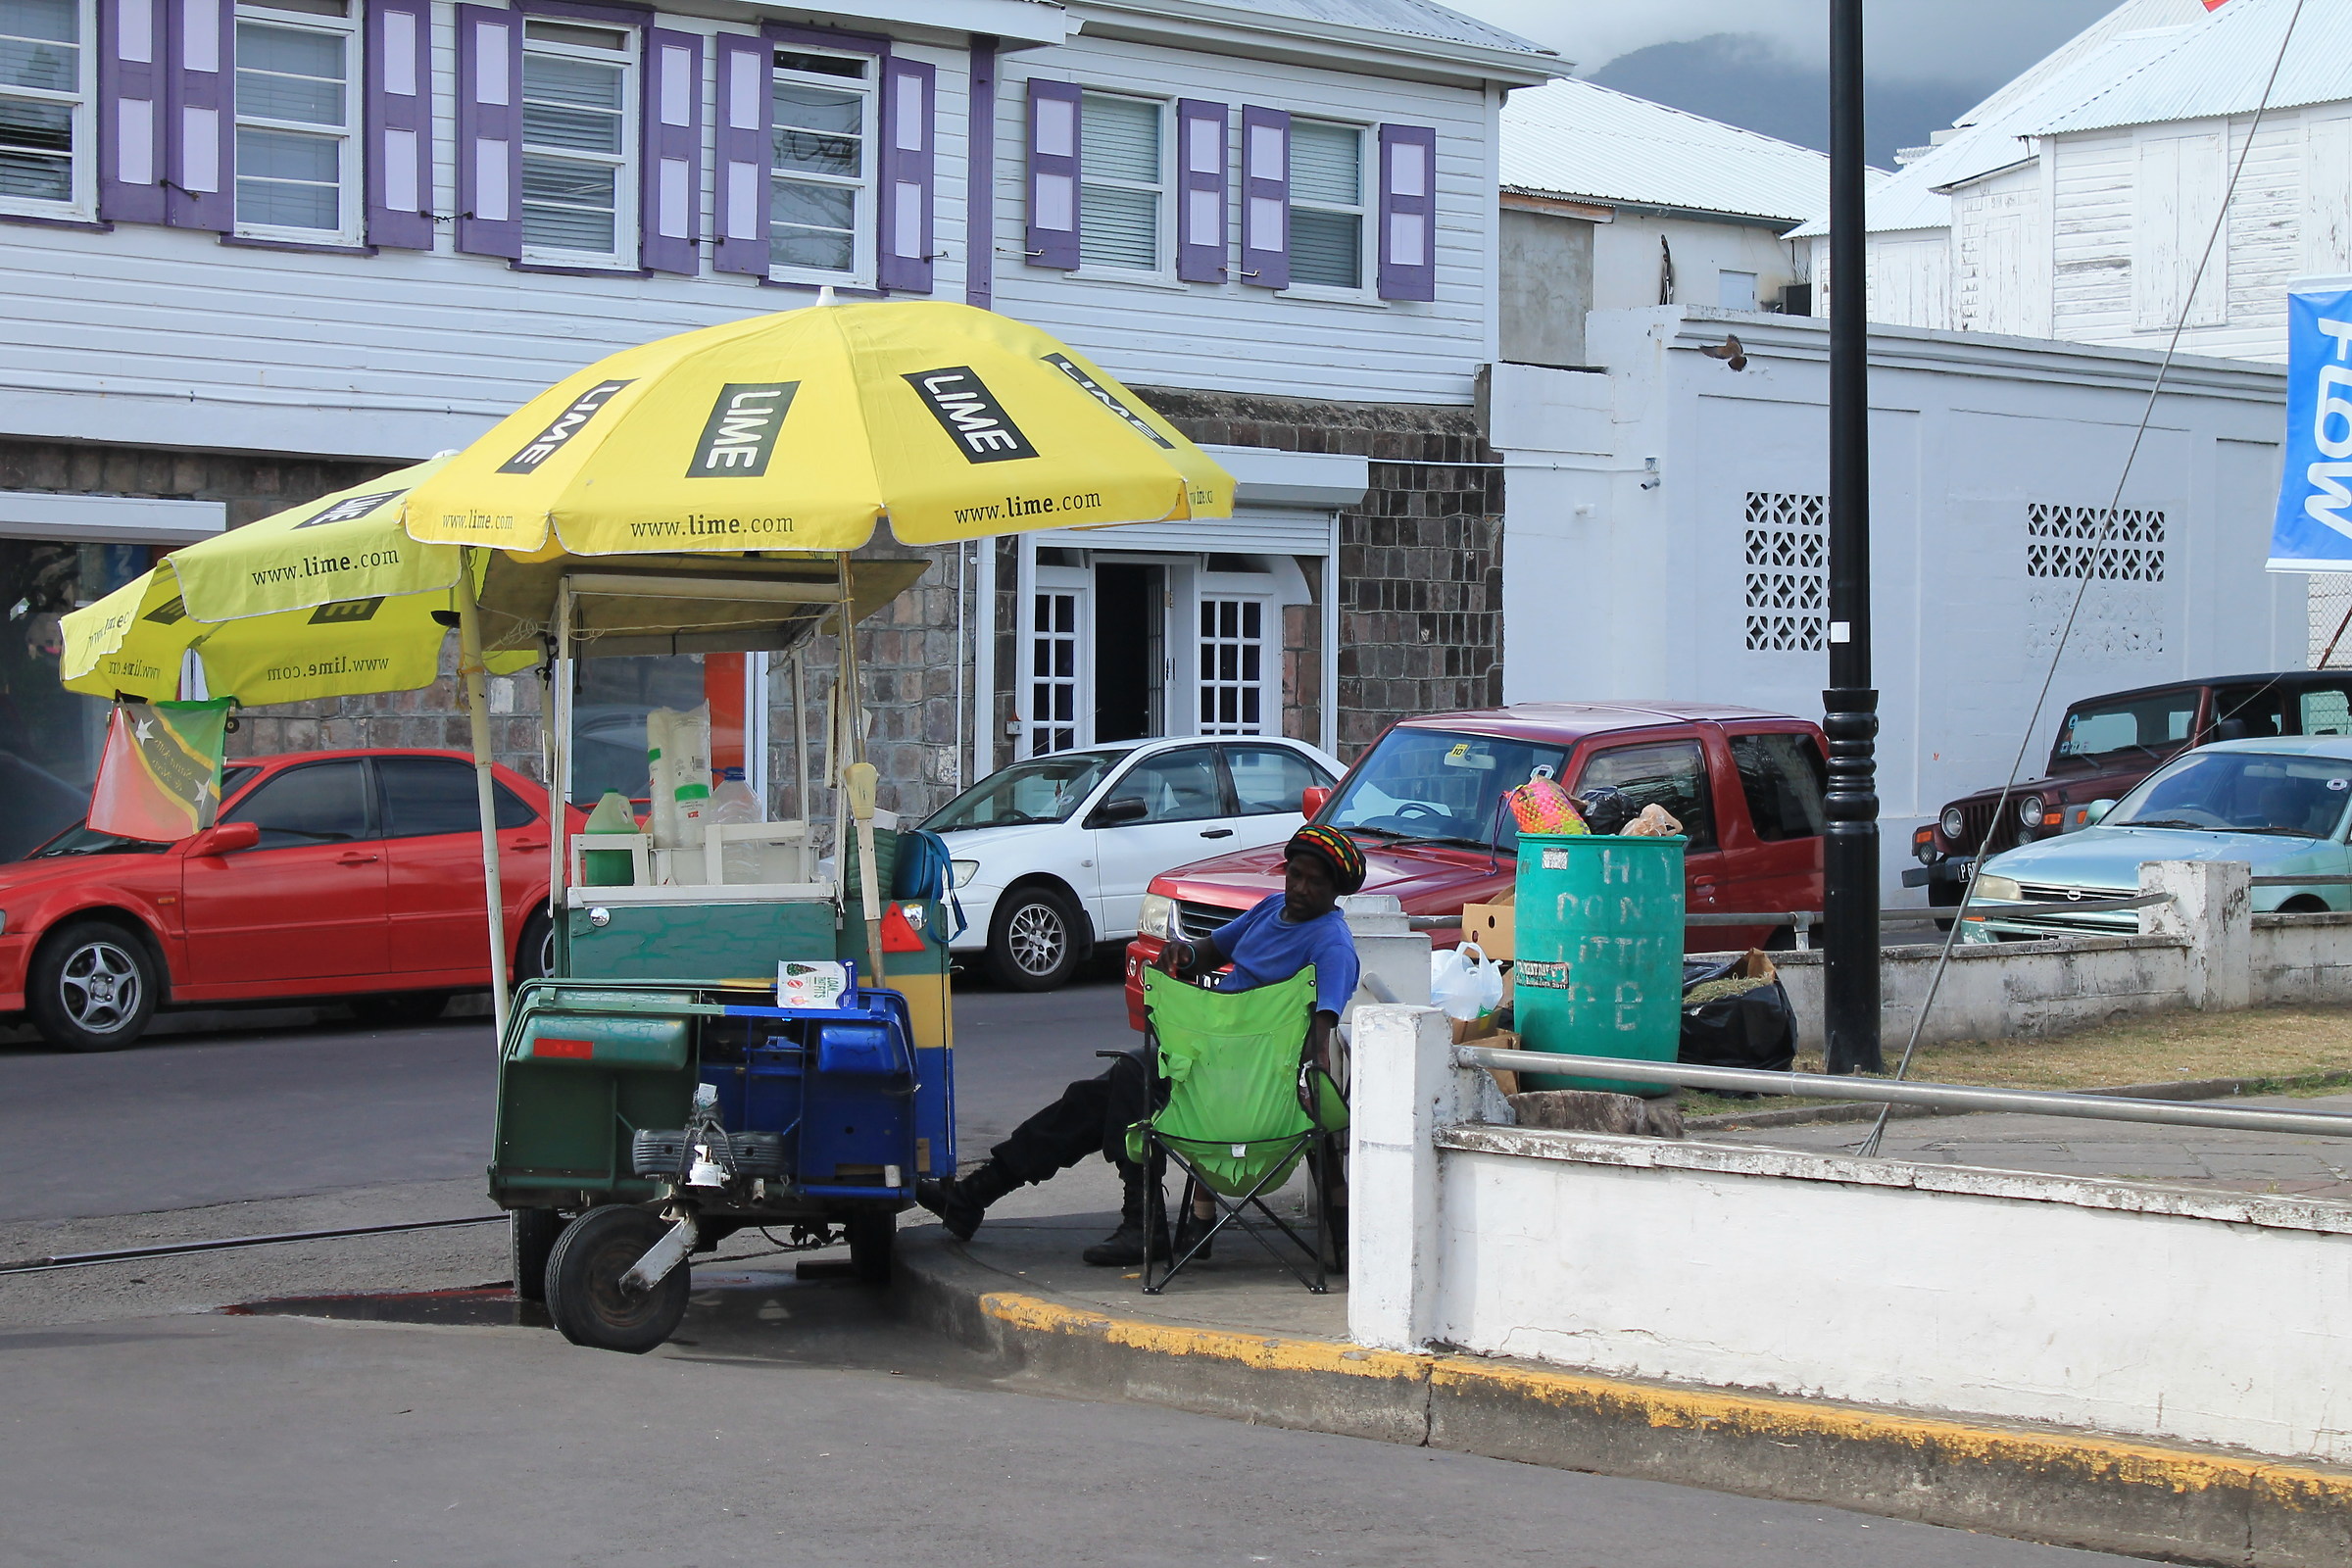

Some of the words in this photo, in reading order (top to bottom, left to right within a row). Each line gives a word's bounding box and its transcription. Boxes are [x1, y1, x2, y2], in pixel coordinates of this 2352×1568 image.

[923, 374, 1018, 453] LIME
[1058, 362, 1161, 440] LIME
[514, 385, 621, 465] LIME
[705, 390, 782, 469] LIME
[442, 509, 514, 530] www.lime.com
[631, 514, 794, 537] www.lime.com
[955, 492, 1102, 524] www.lime.com
[252, 548, 399, 586] www.lime.com
[813, 986, 826, 999] FITS
